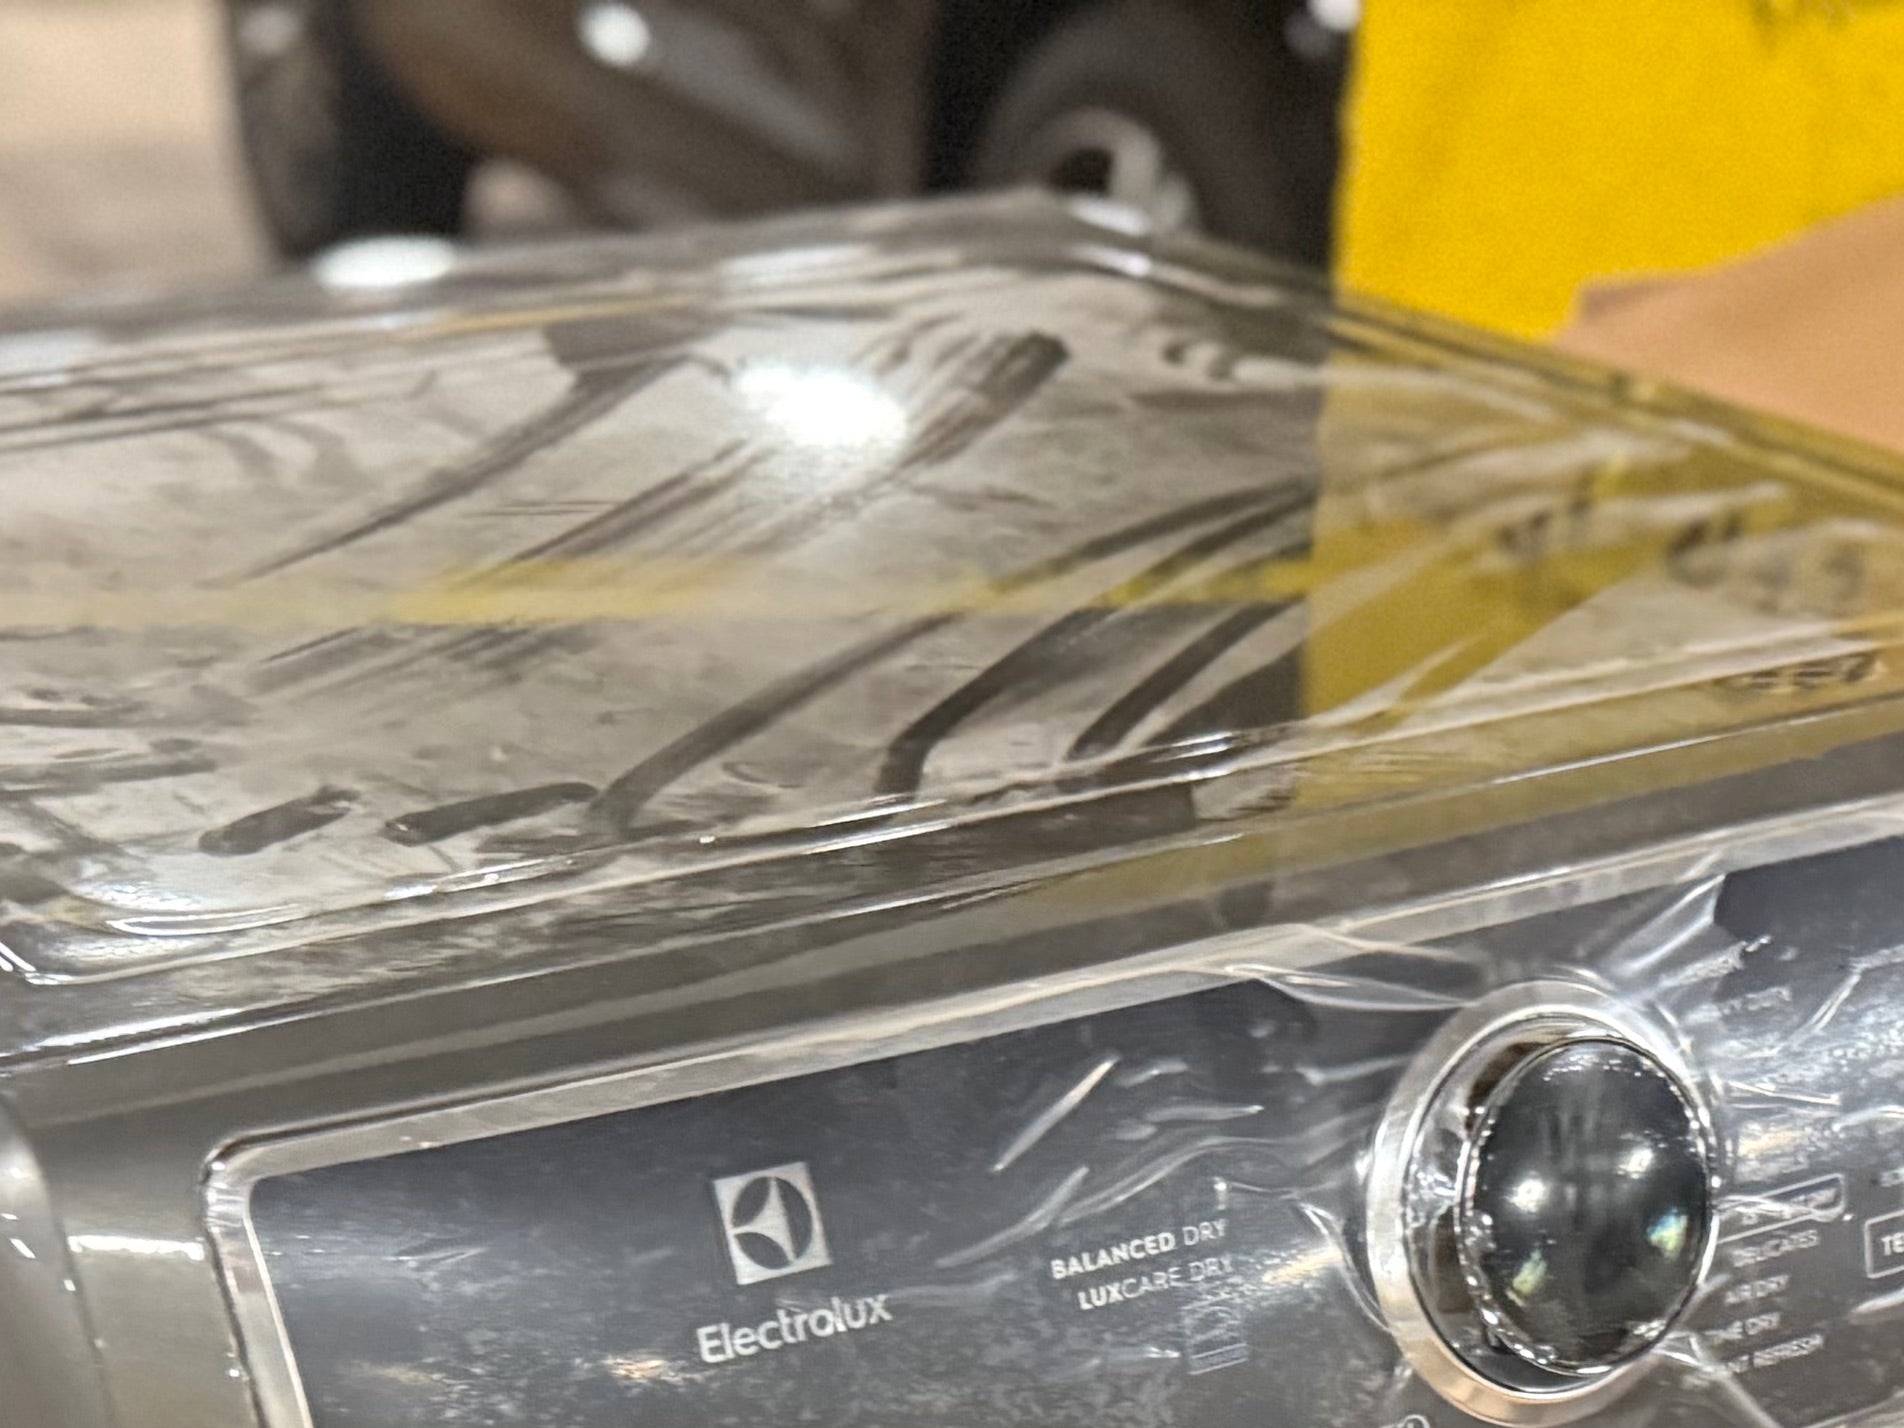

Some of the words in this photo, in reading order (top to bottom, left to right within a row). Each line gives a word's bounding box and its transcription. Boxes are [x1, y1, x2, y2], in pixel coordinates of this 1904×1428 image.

[1050, 1232, 1176, 1280] BALANCED
[1183, 1219, 1228, 1246] DRY
[1077, 1267, 1182, 1310] LUXCARE
[697, 1292, 893, 1365] Electrolux
